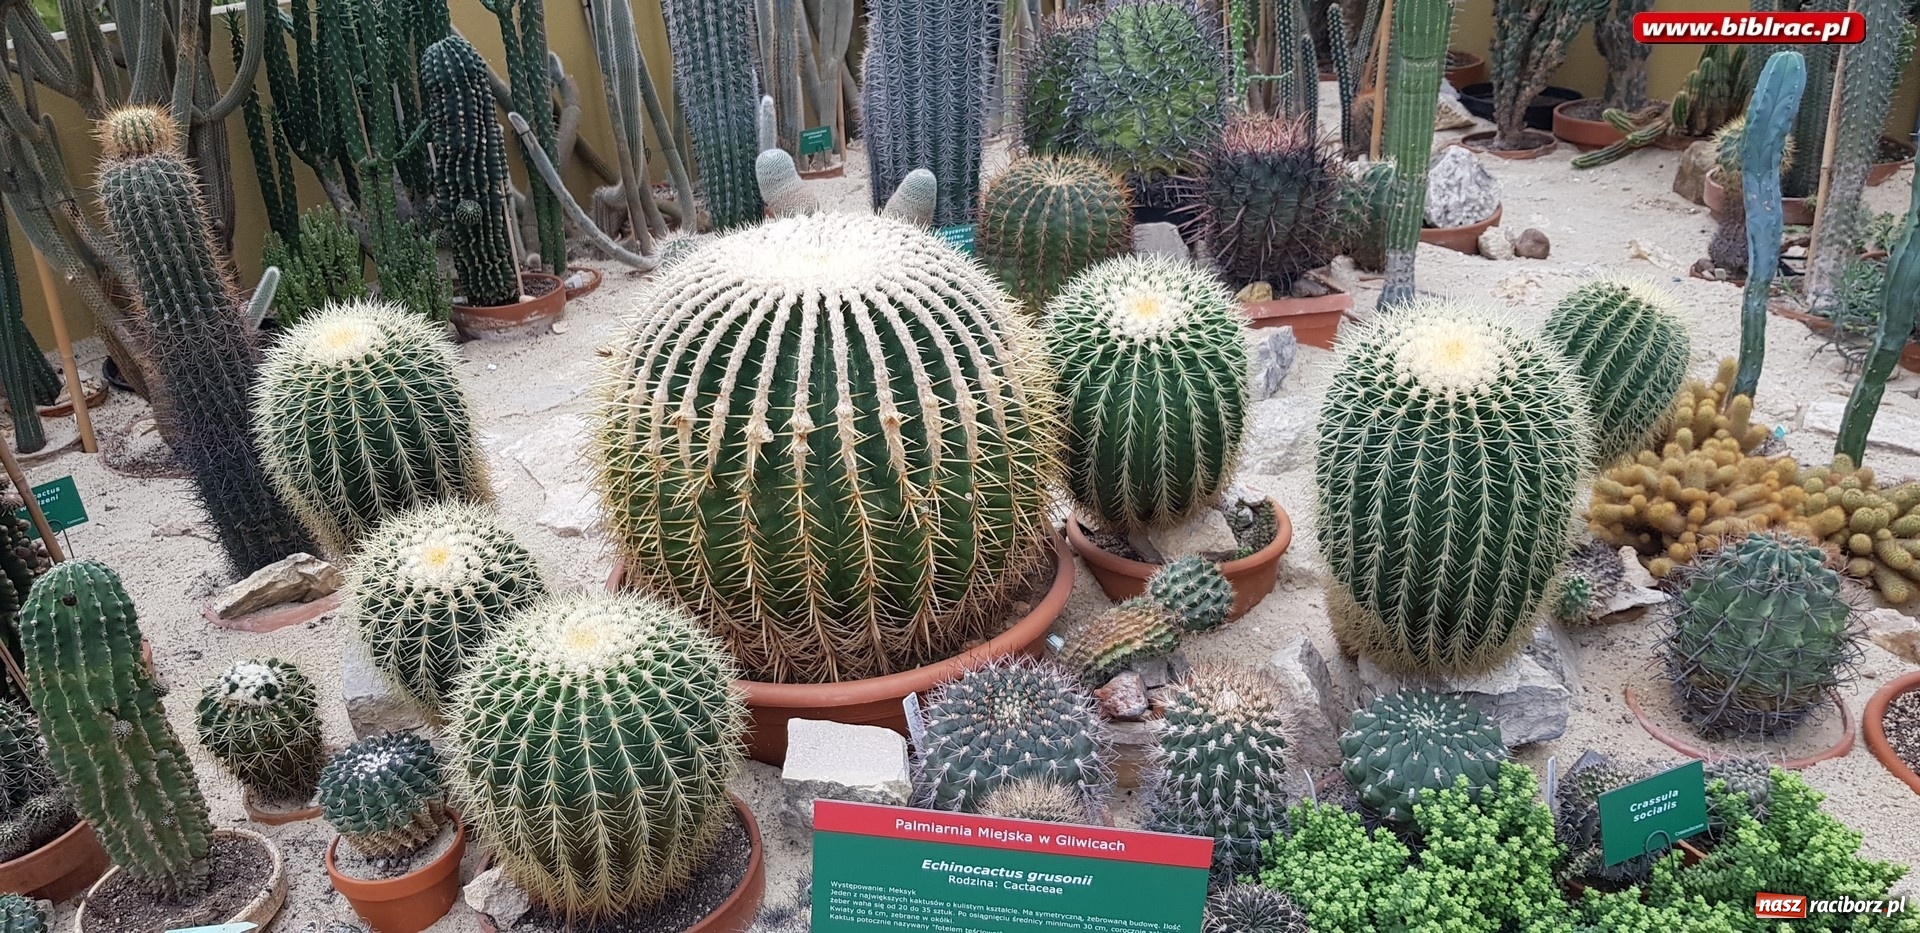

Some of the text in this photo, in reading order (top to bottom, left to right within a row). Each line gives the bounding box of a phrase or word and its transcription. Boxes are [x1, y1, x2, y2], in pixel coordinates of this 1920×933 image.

[1629, 789, 1679, 812] Crassula
[1633, 801, 1677, 822] socialis
[895, 818, 1125, 851] Palmiarnia Miejska w Gliwicach
[922, 860, 1093, 886] Echinocactus grusonii
[831, 881, 916, 896] Występowanie: Meksyk
[949, 875, 1063, 895] Rodzina: Cactaceae
[830, 905, 855, 915] Kwiaty
[891, 913, 920, 921] zebrane
[830, 914, 855, 922] Kaktus
[857, 916, 892, 926] potocznie
[894, 921, 930, 931] nazywany
[1046, 921, 1081, 929] minimum
